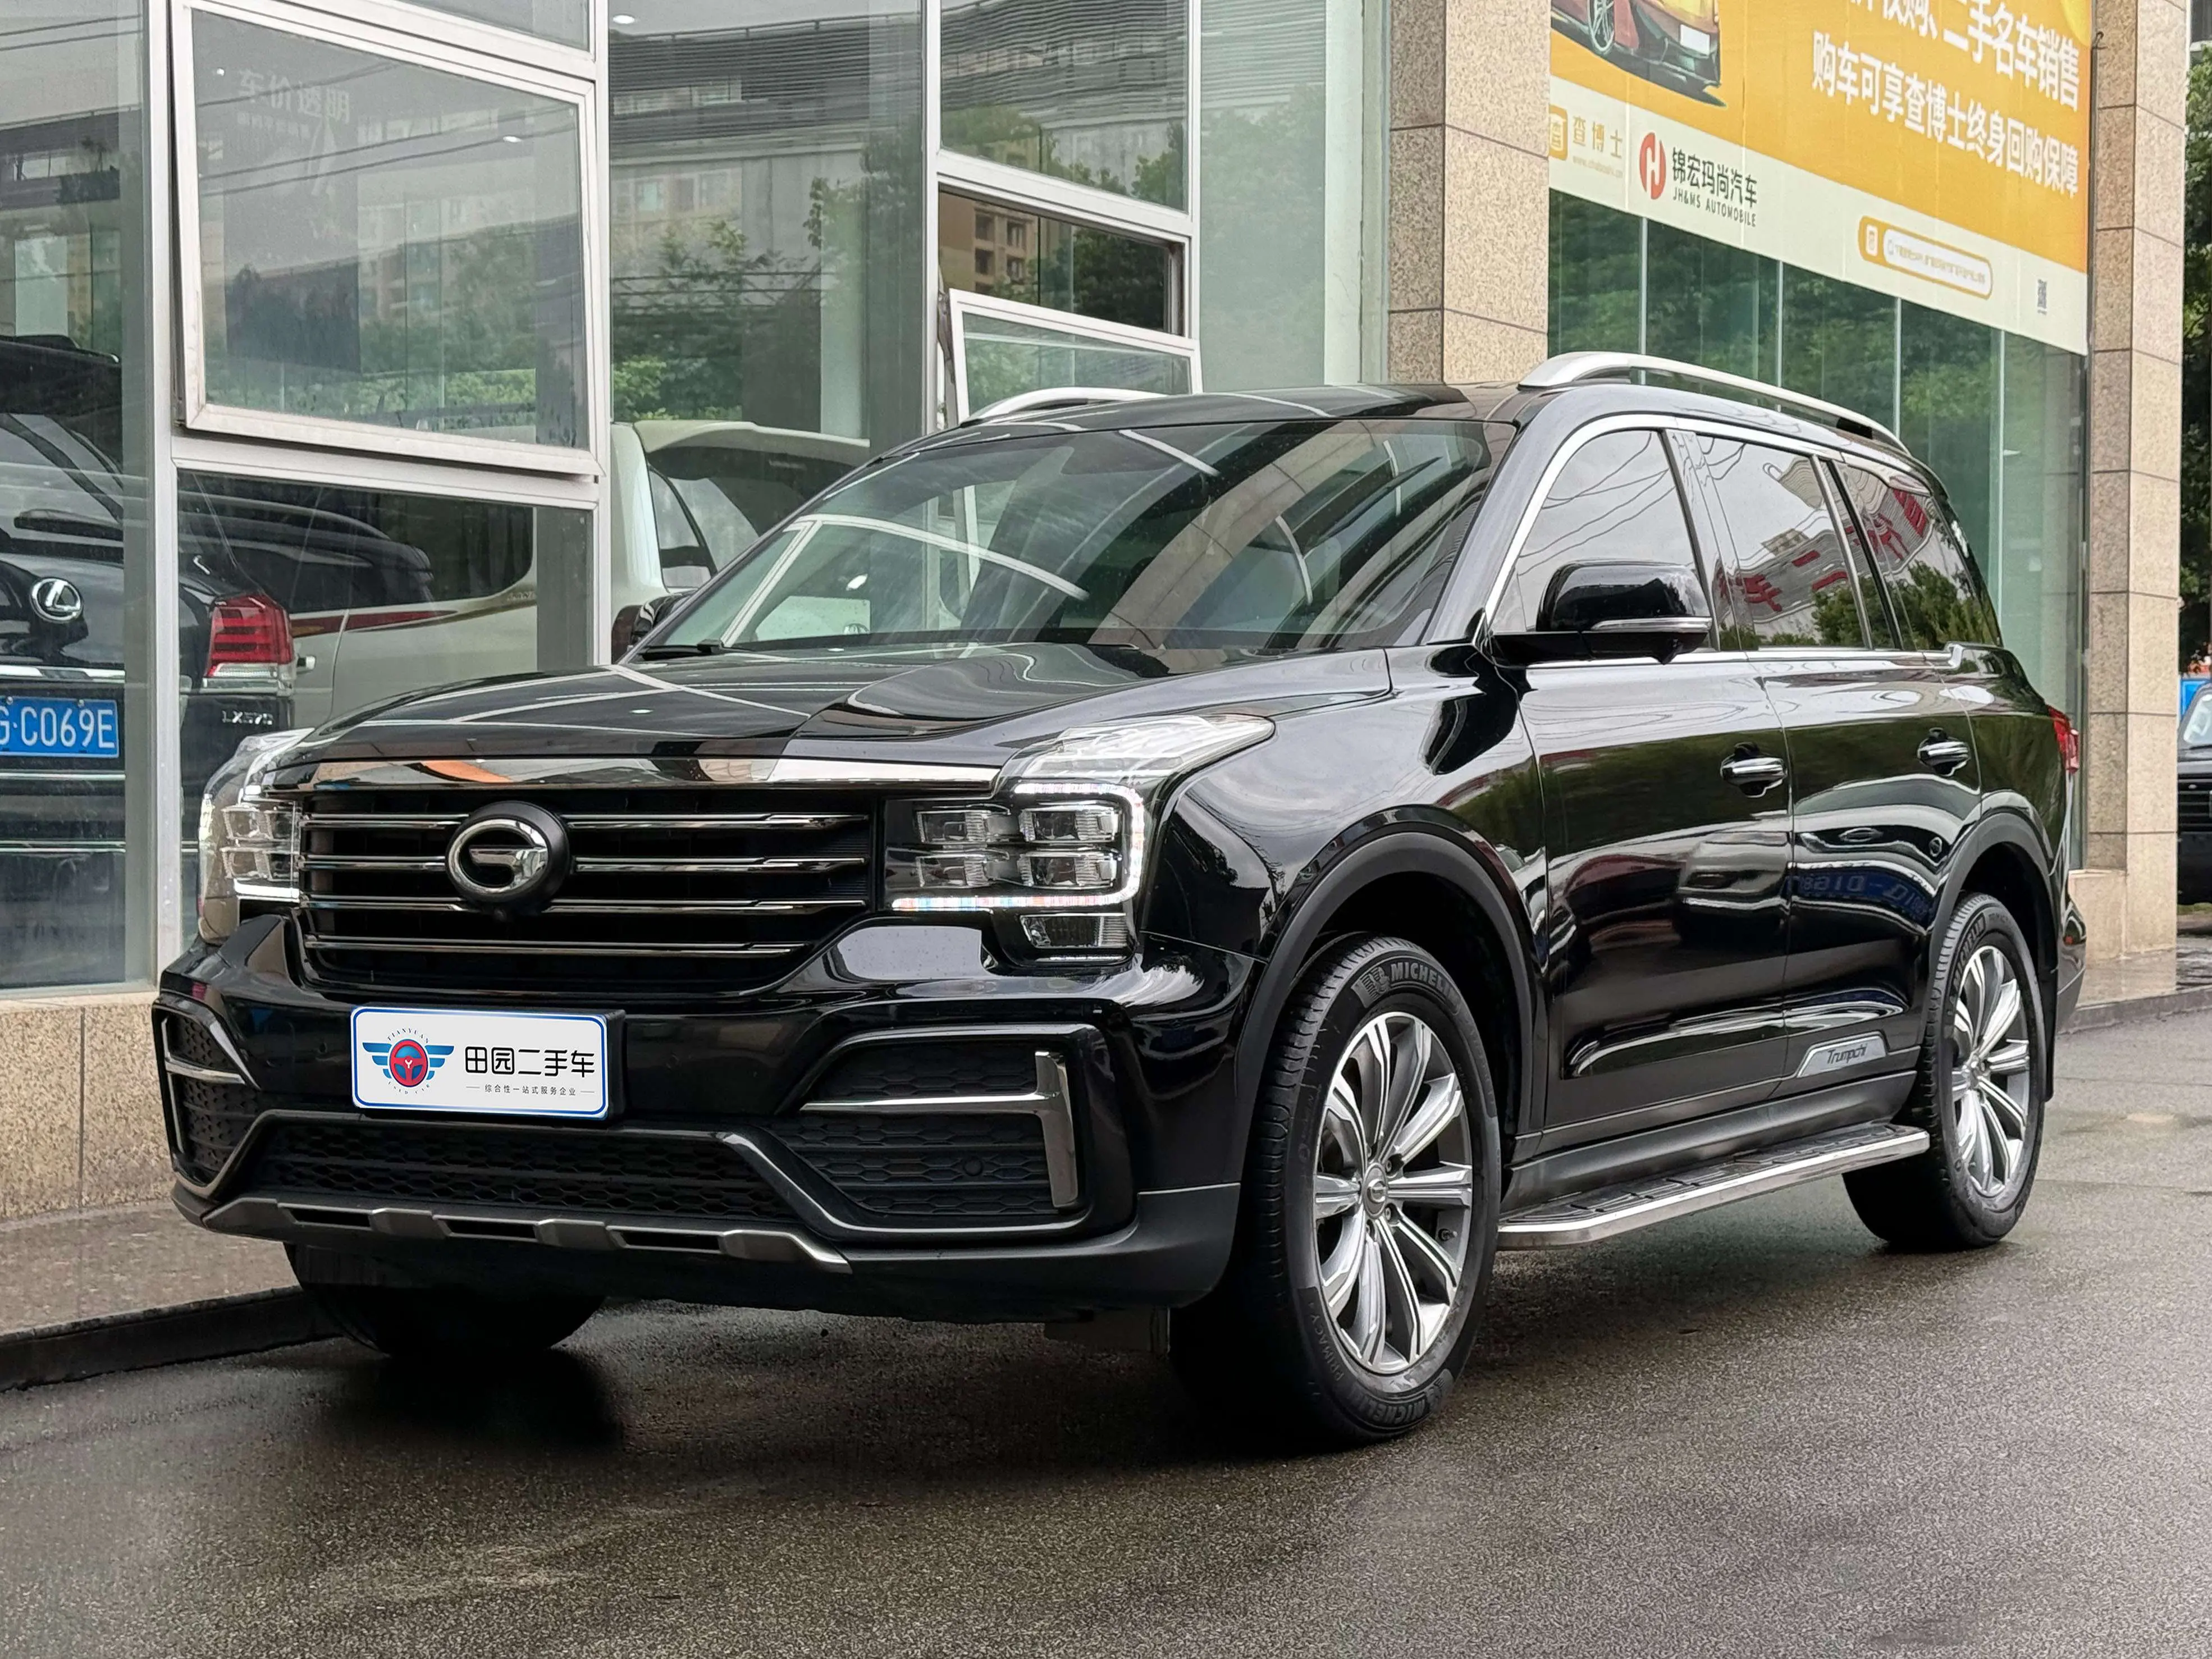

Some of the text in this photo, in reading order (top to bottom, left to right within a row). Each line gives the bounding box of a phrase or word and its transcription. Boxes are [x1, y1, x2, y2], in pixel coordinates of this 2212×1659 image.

[1812, 31, 2080, 198] 购车可享查博士终身回购保障
[1573, 115, 1623, 159] 查博士
[1672, 147, 1757, 208] 锦宏玛尚汽车
[1705, 198, 1756, 227] AUTOMOBILE
[1391, 961, 1461, 1003] MICHELIN
[464, 1045, 595, 1078] 田园二手车
[1827, 1043, 1868, 1064] Trumpchi
[485, 1083, 576, 1096] 综合性一站式服务企业
